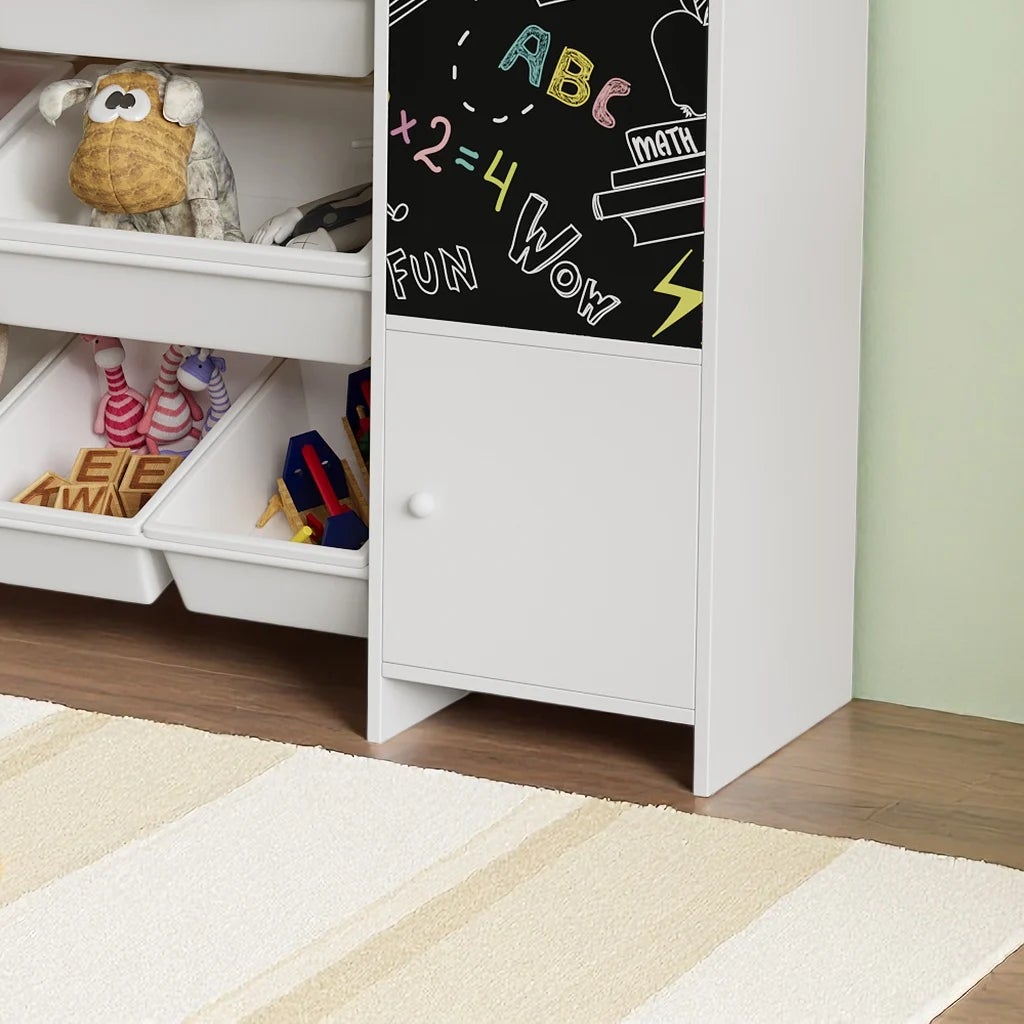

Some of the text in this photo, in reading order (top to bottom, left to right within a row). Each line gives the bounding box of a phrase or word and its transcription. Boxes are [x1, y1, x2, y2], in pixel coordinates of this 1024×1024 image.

[632, 126, 698, 163] MATH
[386, 245, 478, 299] FUN
[76, 450, 118, 482] E
